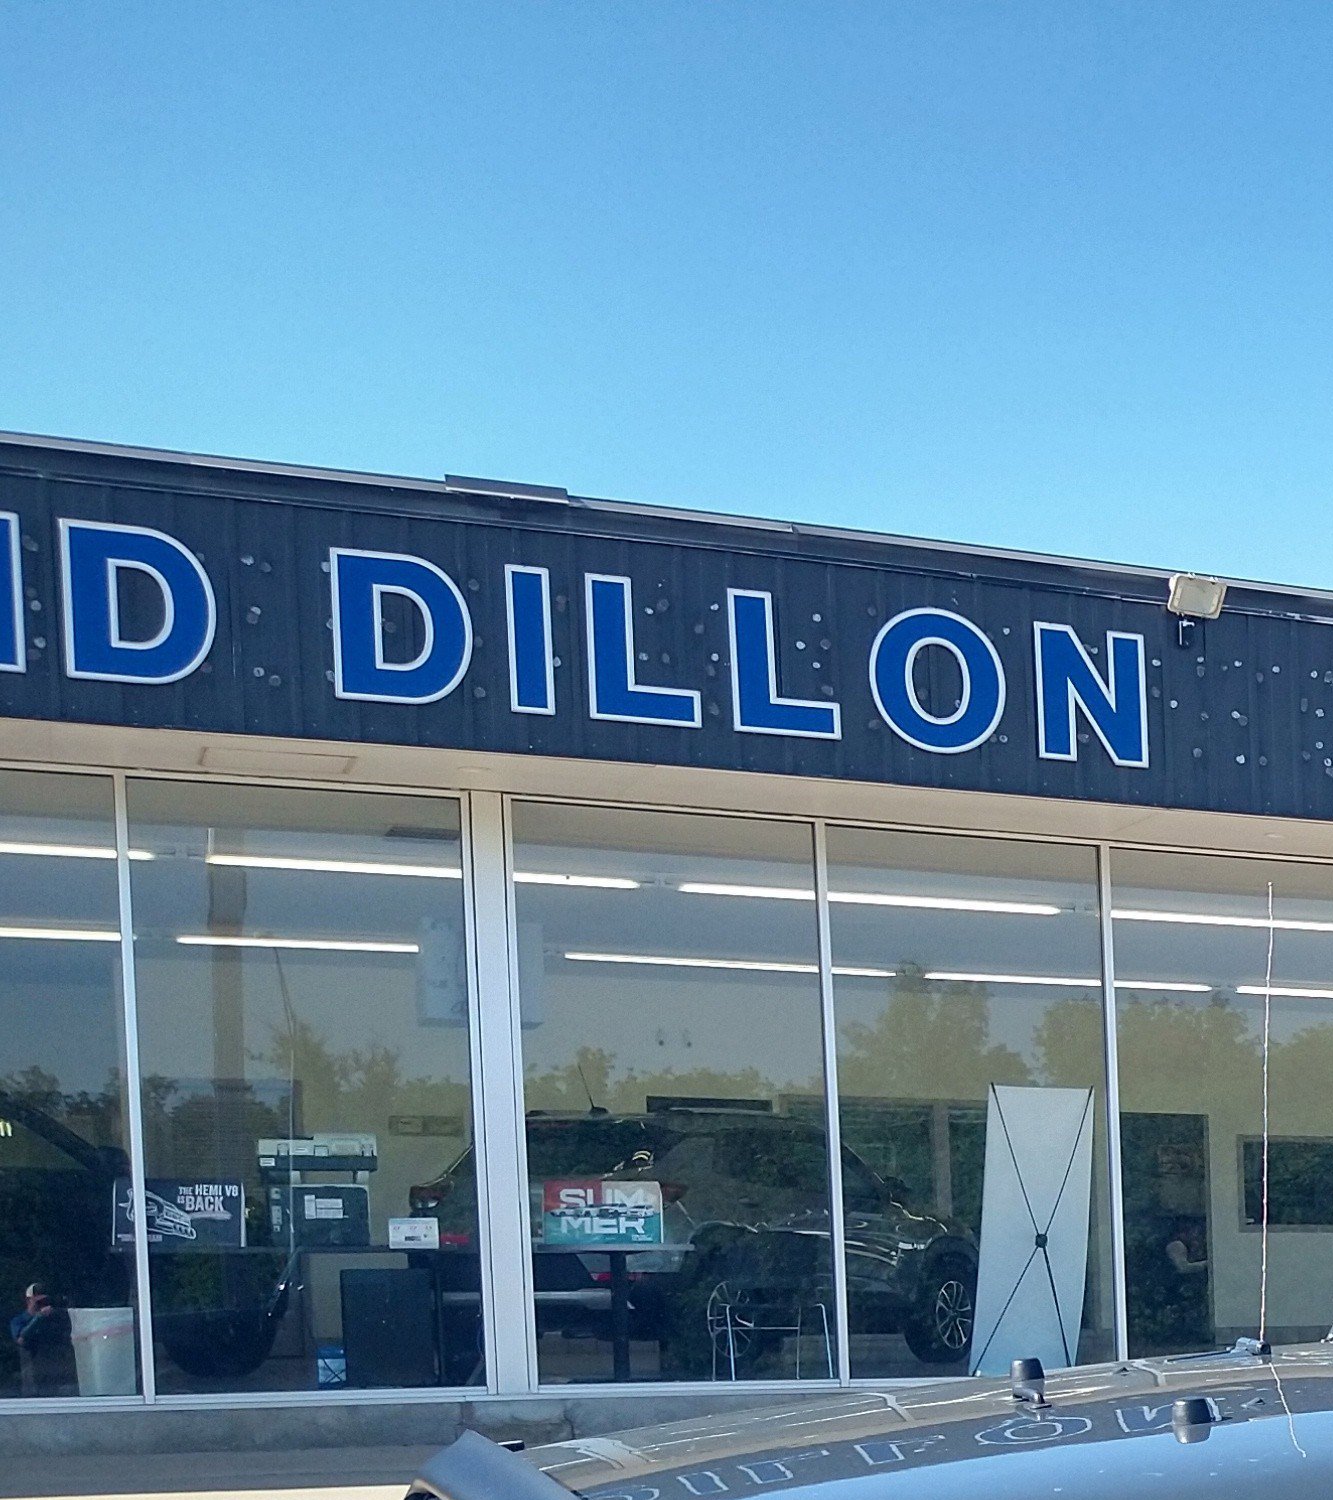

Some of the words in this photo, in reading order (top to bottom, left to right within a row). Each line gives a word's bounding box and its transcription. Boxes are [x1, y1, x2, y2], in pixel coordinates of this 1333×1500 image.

[328, 546, 1151, 768] DILLON
[179, 1186, 193, 1196] THE
[195, 1184, 222, 1196] HEMI
[225, 1185, 239, 1197] V8
[185, 1196, 224, 1212] BACK
[560, 1216, 645, 1234] MER
